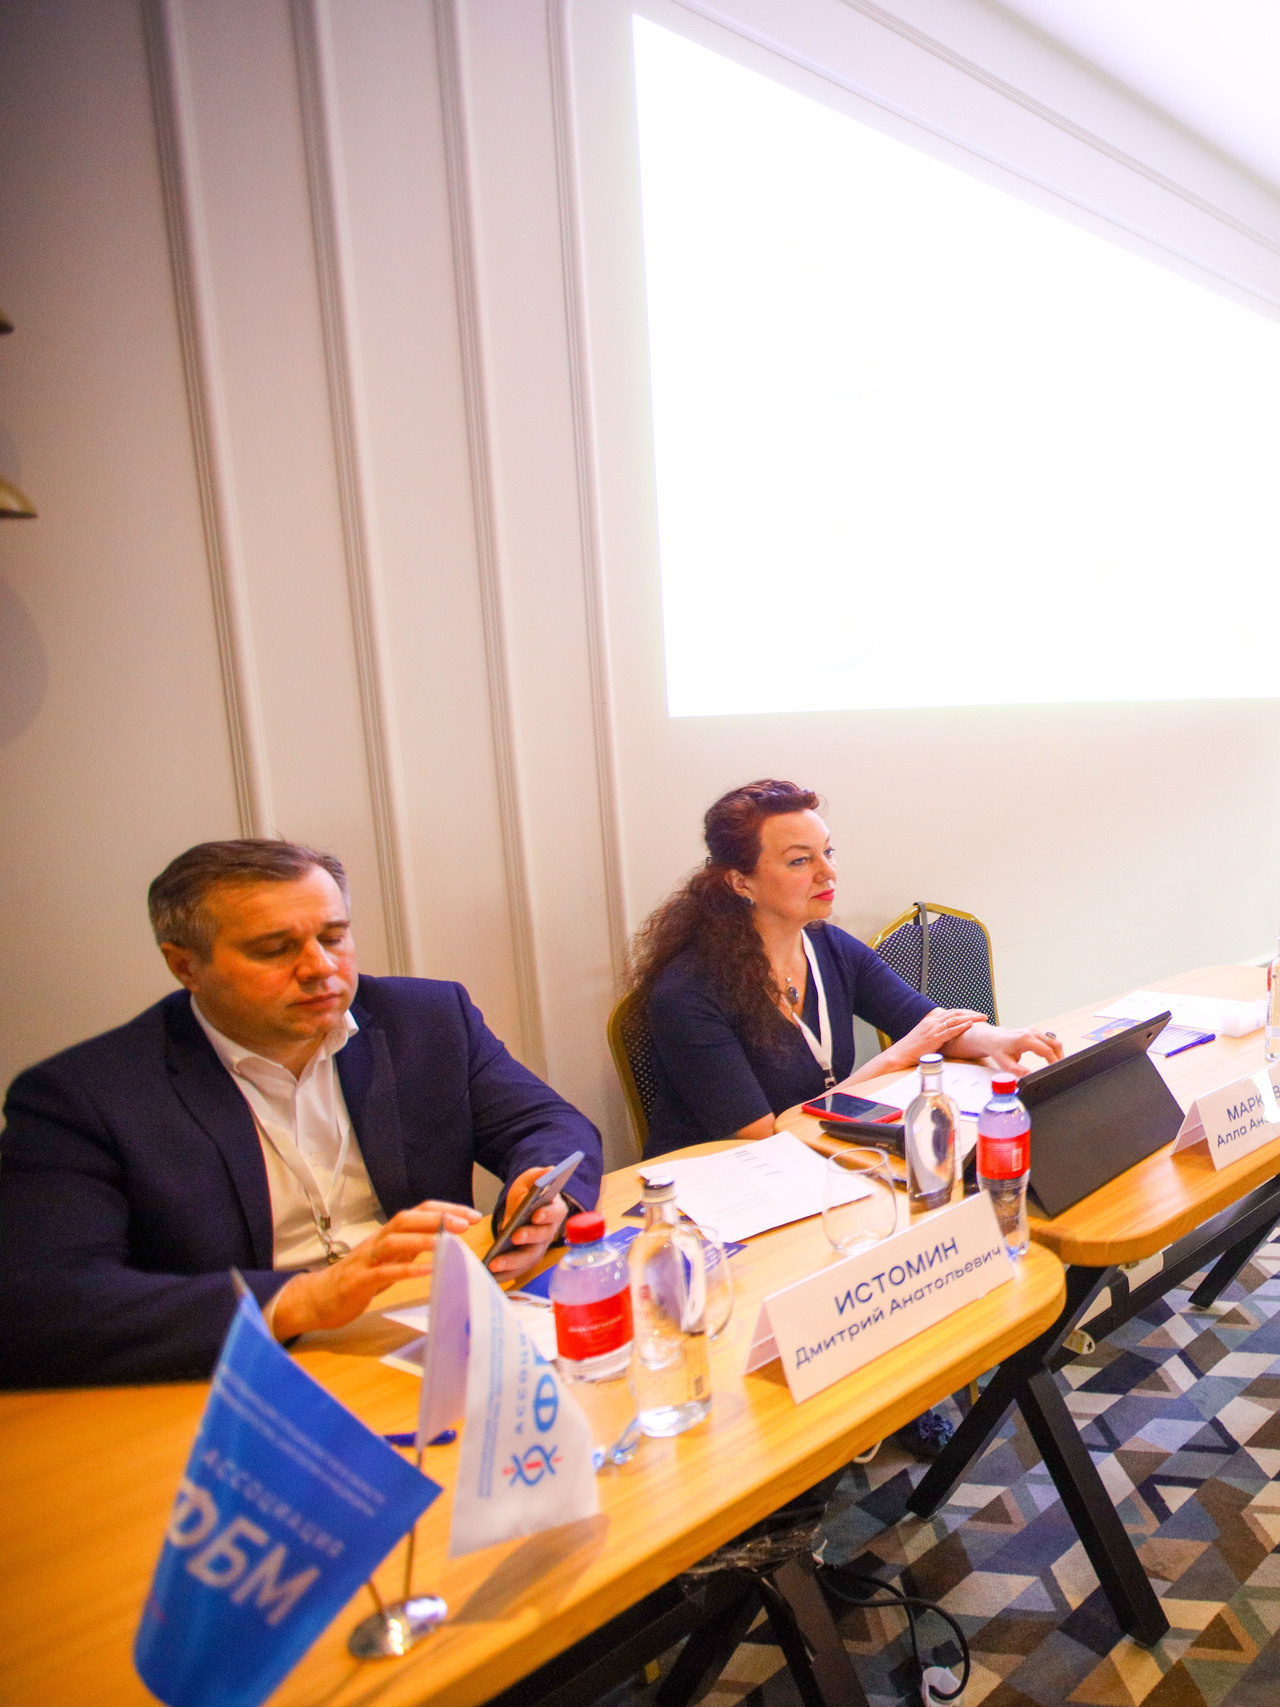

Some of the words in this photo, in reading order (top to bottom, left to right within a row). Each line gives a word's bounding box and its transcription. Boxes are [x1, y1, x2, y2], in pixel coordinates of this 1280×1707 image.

[1217, 1125, 1247, 1148] Алла
[795, 1306, 885, 1369] Дмитрий
[889, 1246, 1001, 1316] Анатольевич
[834, 1237, 959, 1316] ИСТОМИН
